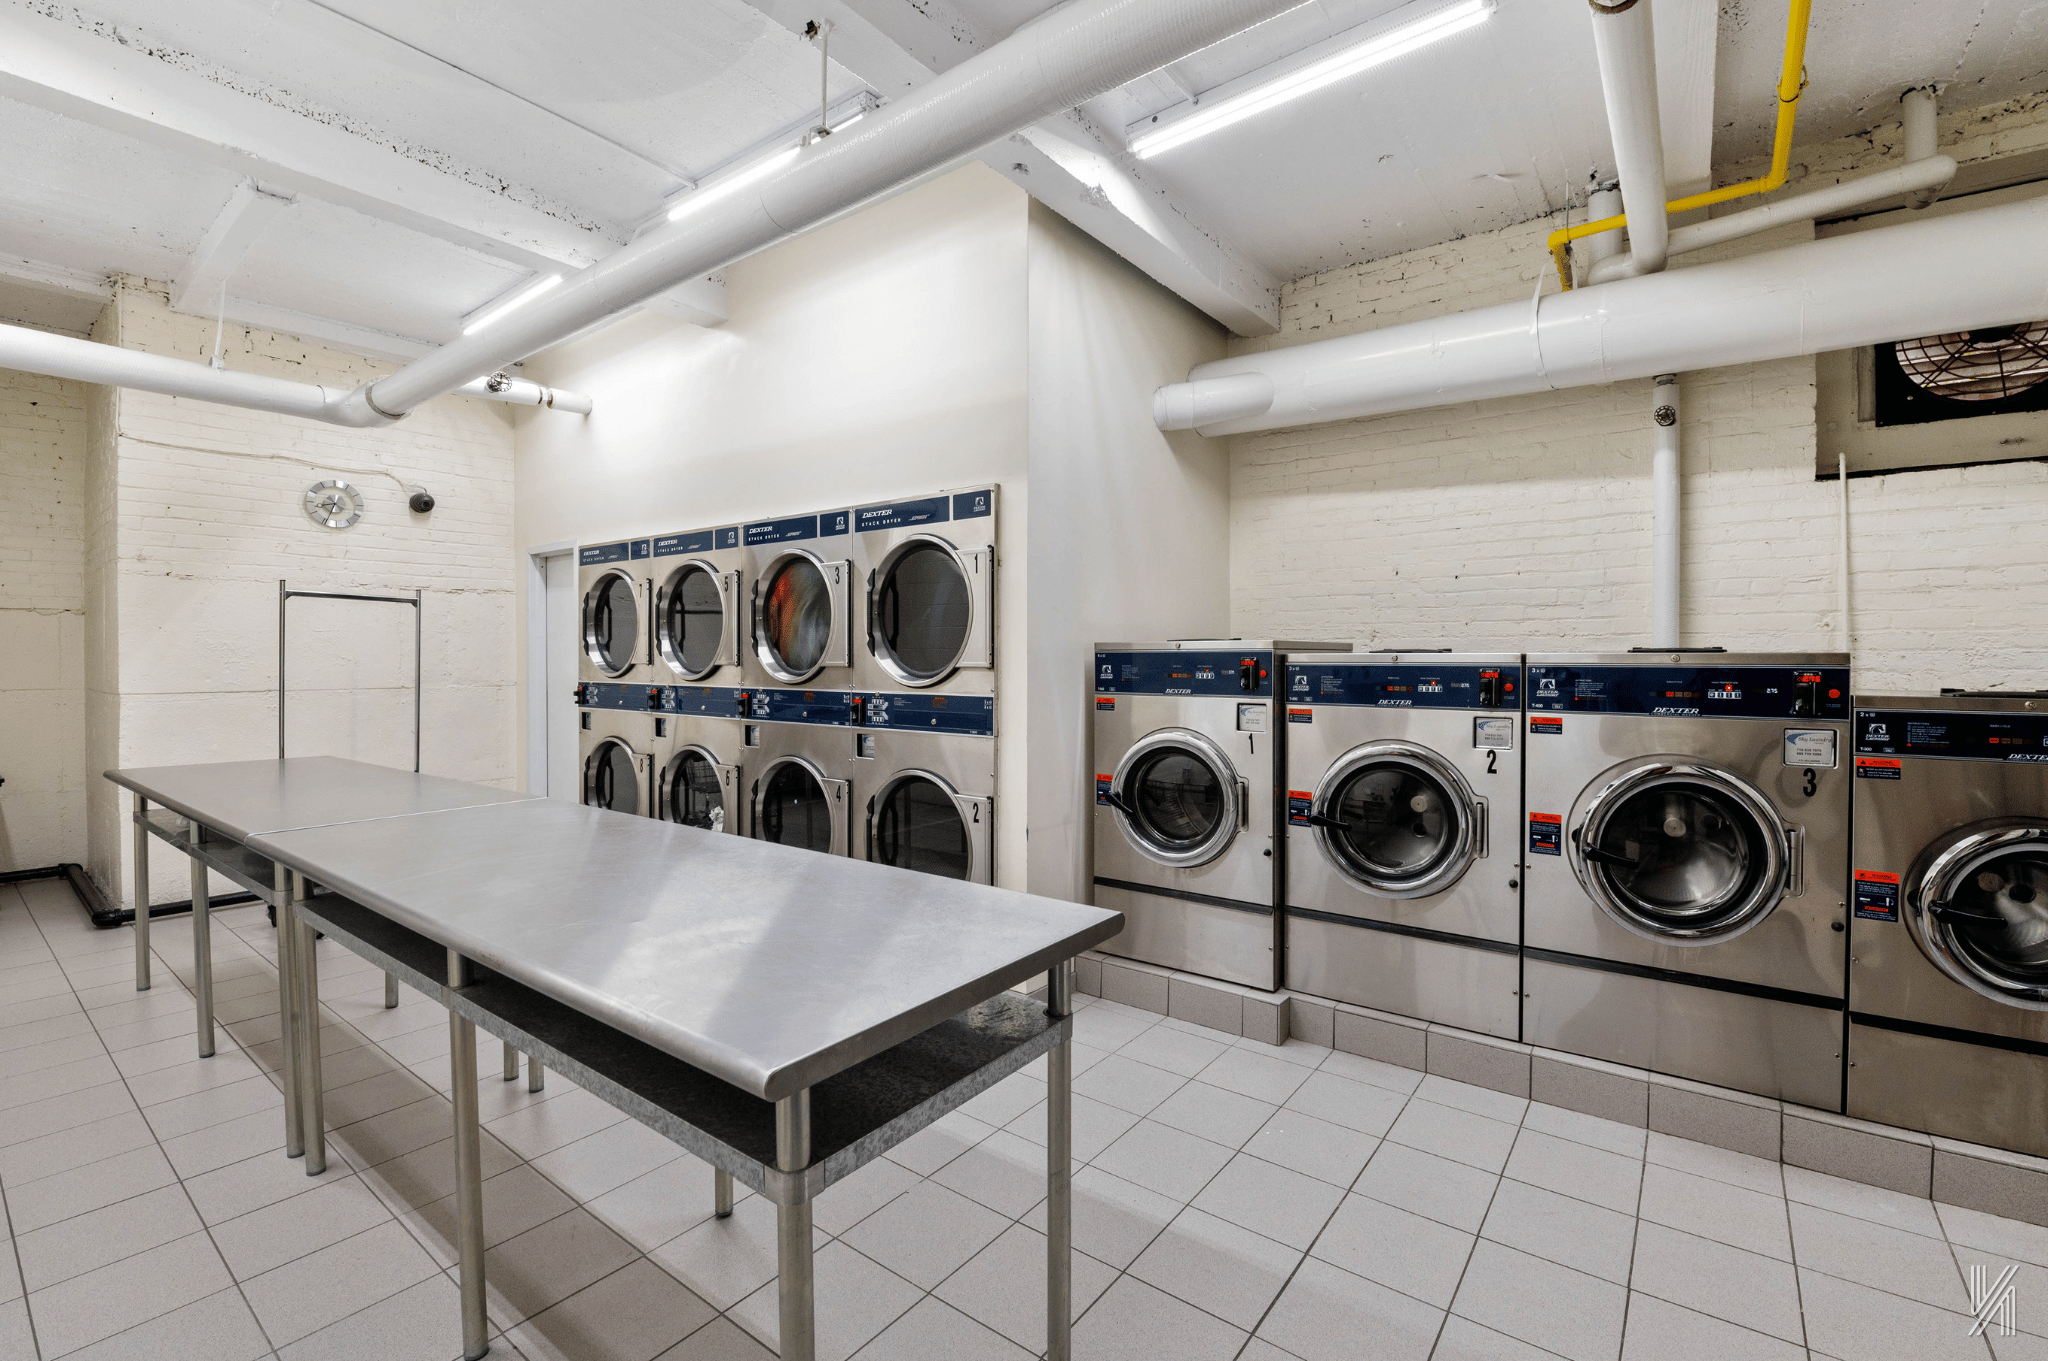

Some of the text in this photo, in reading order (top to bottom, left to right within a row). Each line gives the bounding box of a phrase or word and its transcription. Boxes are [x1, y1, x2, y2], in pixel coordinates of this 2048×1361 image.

[862, 509, 892, 518] DEXTER
[748, 526, 772, 534] DEXTER
[974, 554, 978, 574] 1
[724, 576, 728, 592] 5
[835, 566, 840, 584] 3
[639, 584, 642, 598] 7
[1249, 733, 1254, 754] 1
[640, 758, 644, 773] 8
[1487, 750, 1497, 774] 2
[726, 770, 730, 786] 6
[1803, 768, 1817, 797] 3
[836, 785, 841, 803] 4
[973, 802, 980, 824] 2
